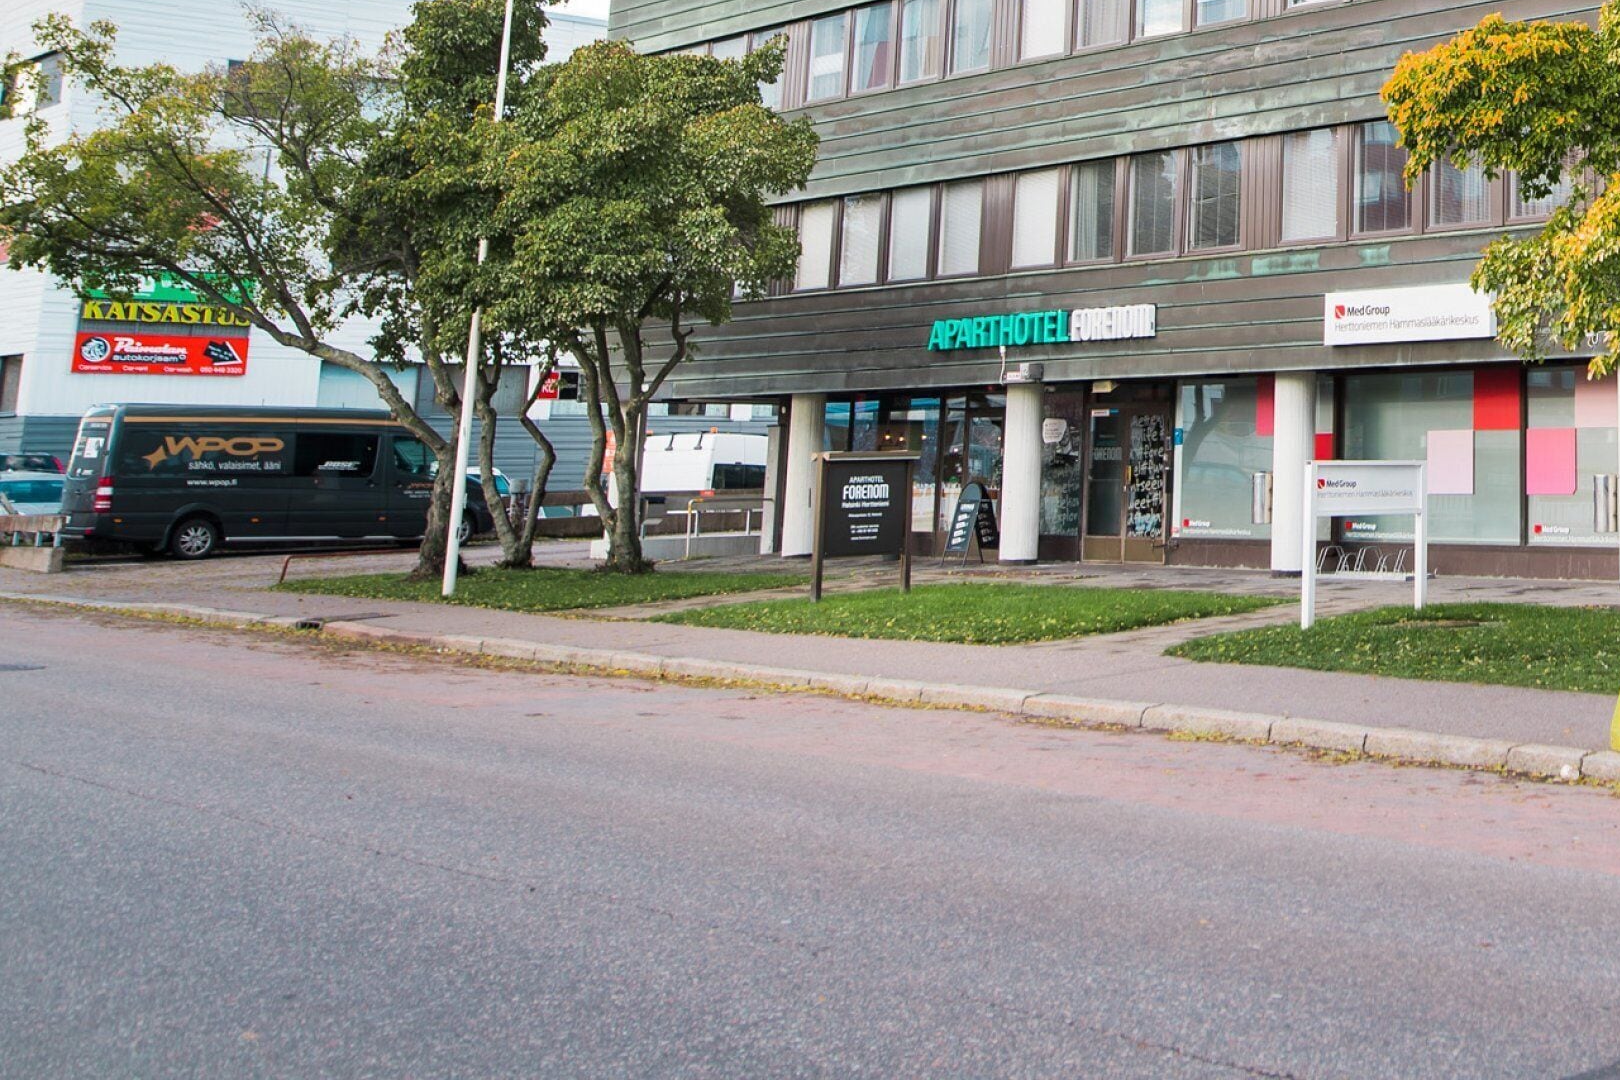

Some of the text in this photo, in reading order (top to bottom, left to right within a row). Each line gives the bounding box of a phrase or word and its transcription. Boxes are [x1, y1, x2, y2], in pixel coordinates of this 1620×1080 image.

[83, 301, 251, 327] KATSASTUS
[1335, 315, 1479, 332] Herttoniemen Hammaslääkärikeskus
[928, 304, 1156, 351] APARTHOTEL FORENOM
[164, 436, 285, 461] WPOP
[188, 460, 216, 471] sähkö,
[263, 460, 282, 470] ääni
[842, 483, 889, 500] FORENOM
